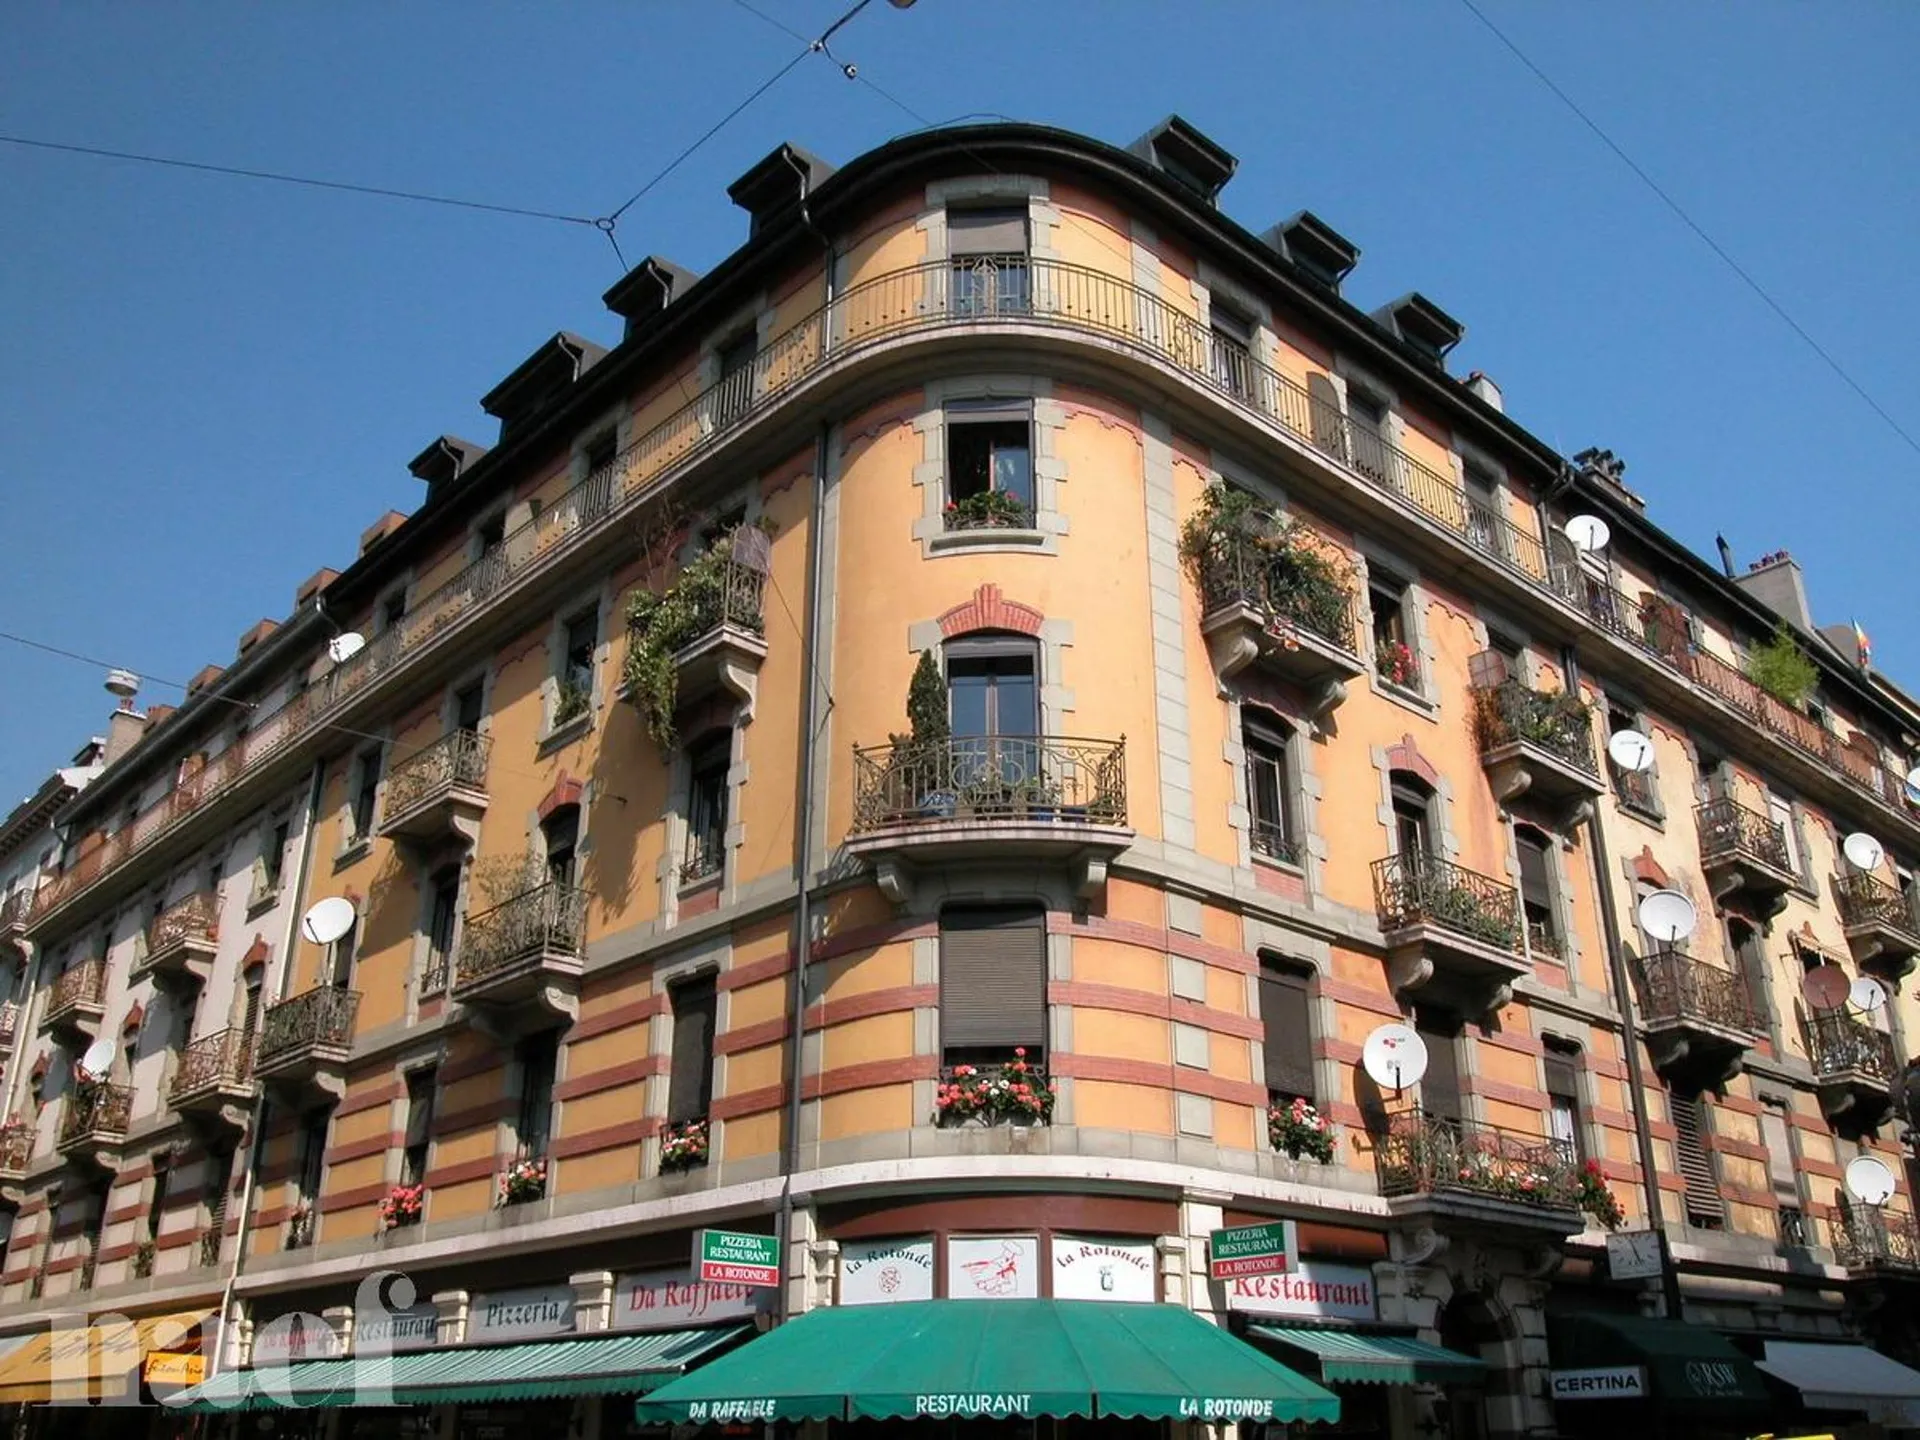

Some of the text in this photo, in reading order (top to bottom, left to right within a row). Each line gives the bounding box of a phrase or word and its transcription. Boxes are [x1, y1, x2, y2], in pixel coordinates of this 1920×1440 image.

[720, 1235, 763, 1249] PIZZERIA
[1226, 1227, 1269, 1243] PIZZERIA
[709, 1246, 772, 1262] RESTAURANT
[1218, 1236, 1280, 1255] RESTAURANT
[867, 1248, 932, 1269] Rotonde
[1079, 1246, 1150, 1271] Rotonde
[1219, 1256, 1281, 1275] LA ROTONDE
[709, 1266, 770, 1281] LA ROTONDE
[629, 1284, 656, 1311] Da
[1233, 1275, 1371, 1306] Restaurant
[485, 1296, 559, 1328] Pizzeria
[1554, 1375, 1639, 1392] CERTINA
[689, 1400, 776, 1419] DA RAFFAELE
[915, 1394, 1031, 1413] RESTAURANT
[1180, 1398, 1273, 1417] LA ROTONDE
